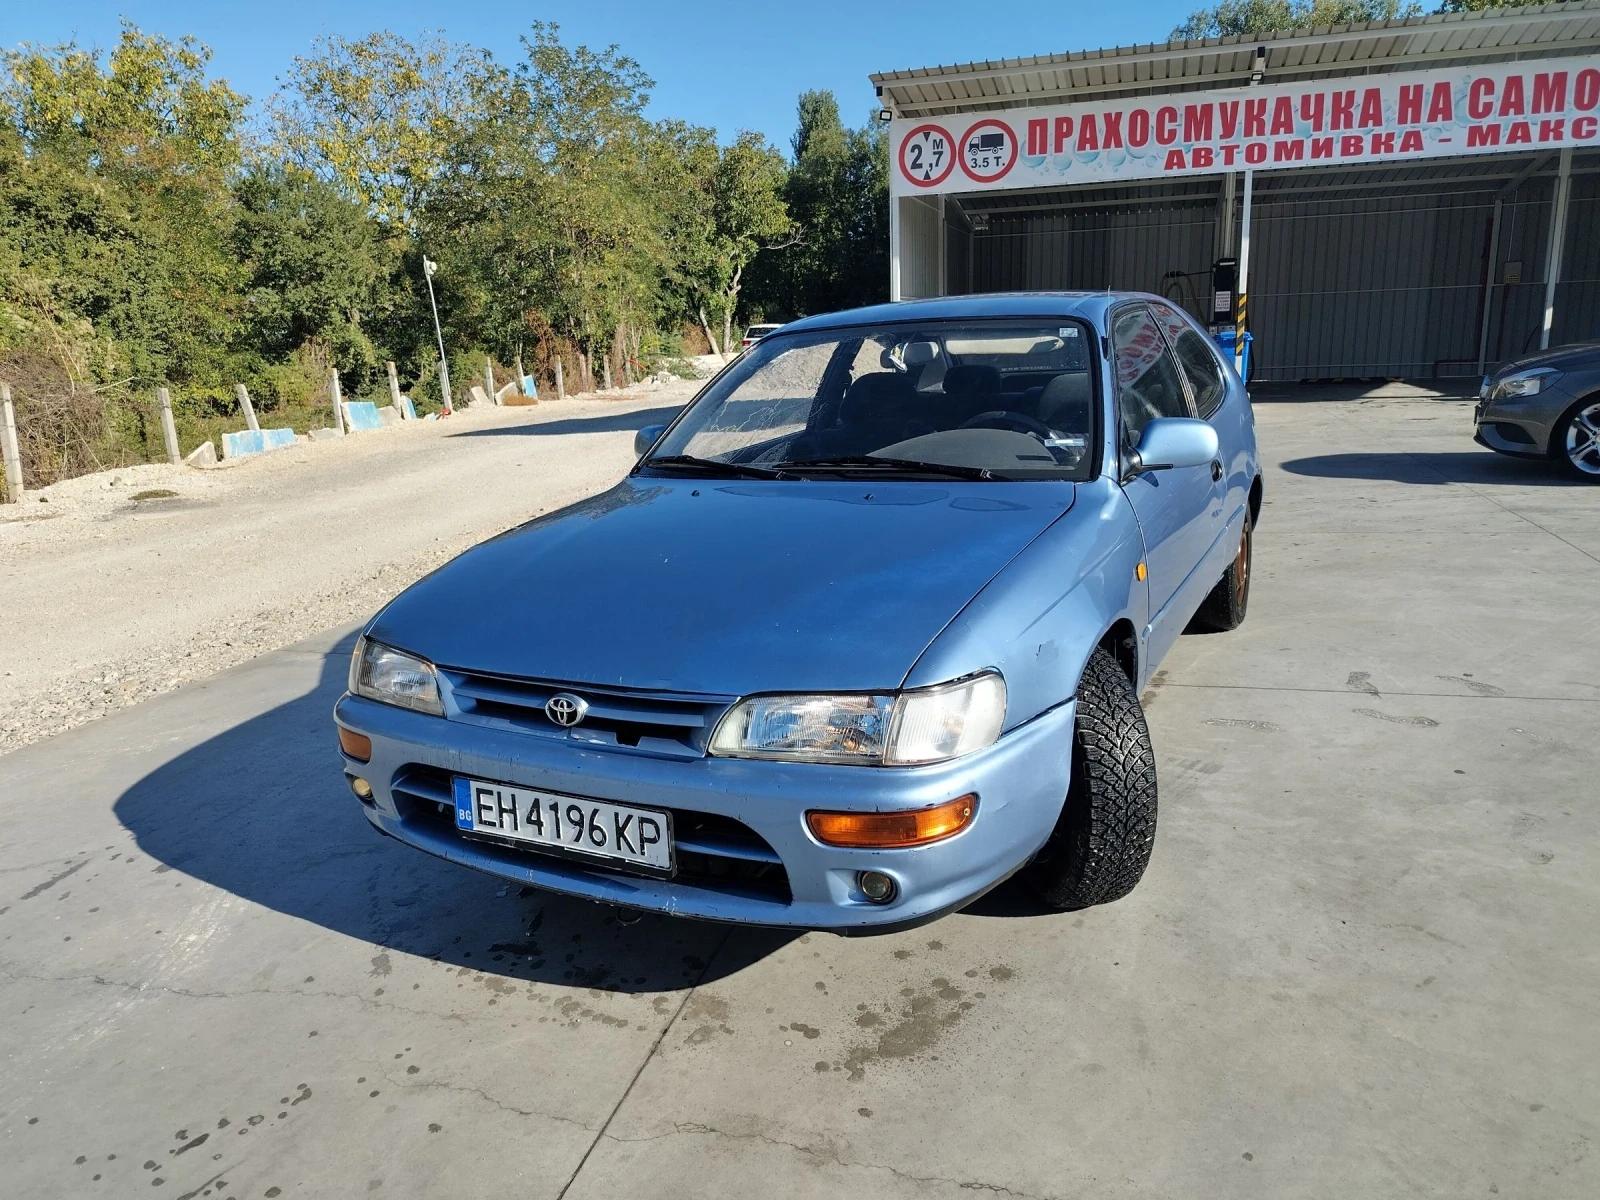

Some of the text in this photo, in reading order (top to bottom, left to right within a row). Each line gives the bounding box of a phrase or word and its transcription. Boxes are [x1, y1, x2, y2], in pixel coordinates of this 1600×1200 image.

[1027, 68, 1600, 156] ПРАХОСМУКАЧКА НА САМО
[970, 157, 990, 169] 3.5
[1163, 130, 1424, 170] АВТОМИВКА
[1466, 116, 1599, 148] МАКС
[458, 808, 472, 822] BG
[525, 797, 609, 847] 4196
